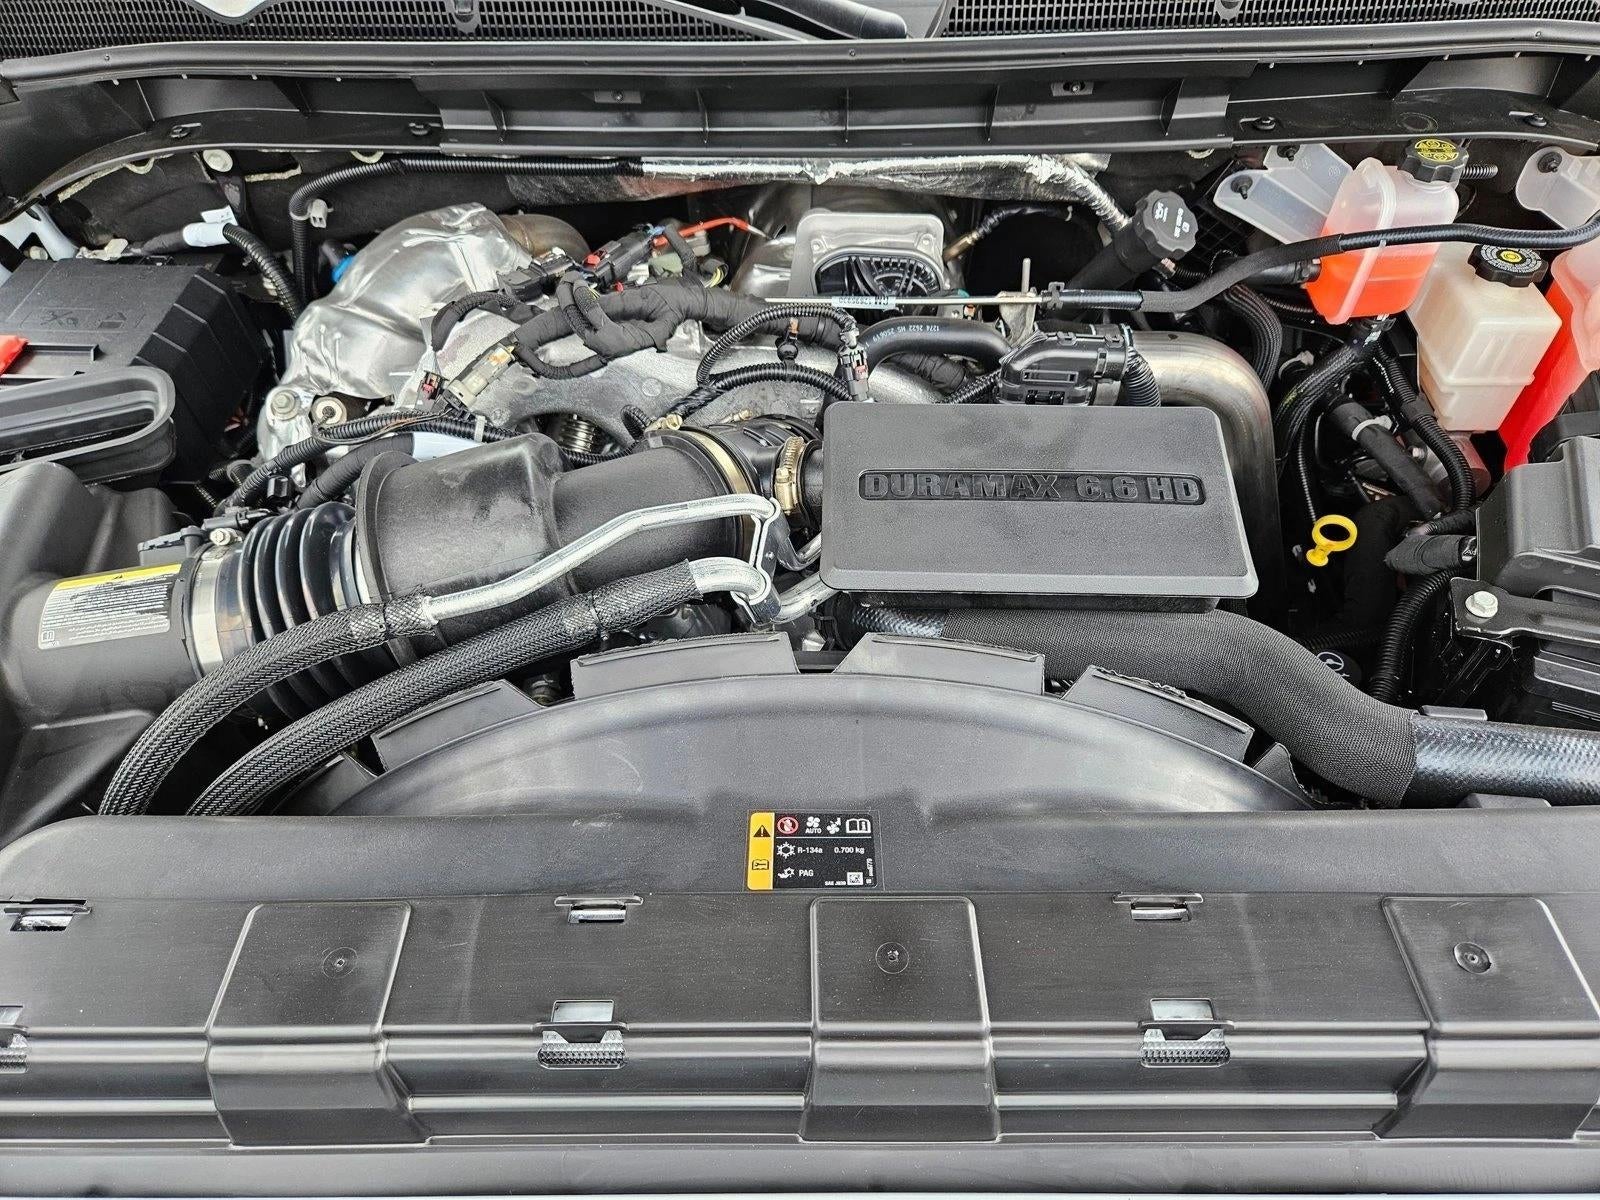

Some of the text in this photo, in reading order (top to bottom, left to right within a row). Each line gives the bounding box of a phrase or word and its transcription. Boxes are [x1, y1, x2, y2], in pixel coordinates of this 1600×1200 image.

[863, 473, 1201, 501] DURAMAX 6.6 HD
[797, 846, 865, 855] R-134a 0.700 kg
[798, 869, 814, 877] PAG
